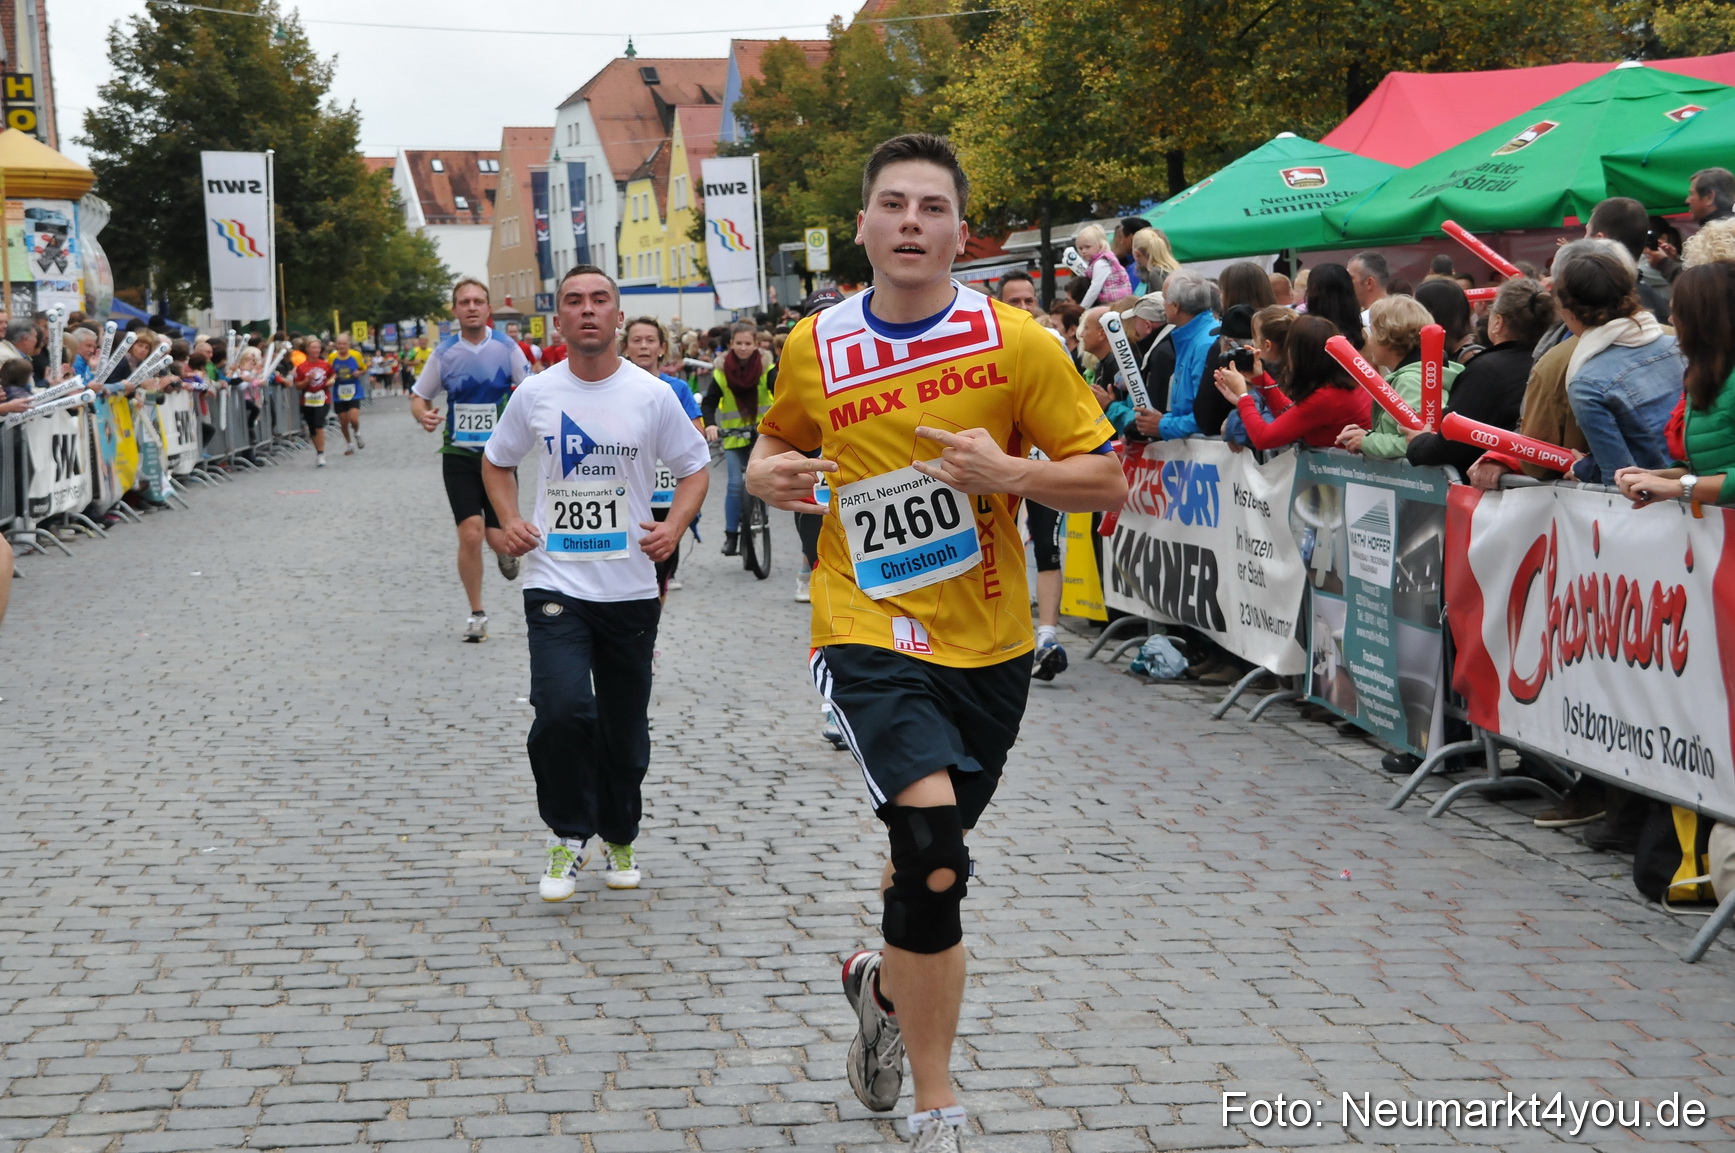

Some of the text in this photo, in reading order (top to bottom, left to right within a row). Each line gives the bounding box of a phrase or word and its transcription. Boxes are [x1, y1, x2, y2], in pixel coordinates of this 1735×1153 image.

[1115, 338, 1134, 373] BMW
[828, 362, 1008, 432] MAX BÖGL
[1377, 382, 1421, 423] Audi BKK
[459, 414, 493, 430] 2125
[573, 462, 616, 476] Team
[1509, 441, 1569, 467] Audi BKK
[547, 489, 613, 497] PARTL Neumarkt
[840, 474, 937, 509] PARTL Neumarkt
[554, 500, 617, 530] 2831
[854, 487, 961, 554] 2460
[563, 537, 611, 549] Christian
[1367, 535, 1391, 553] HOFFER
[880, 543, 958, 580] Christoph
[1507, 515, 1694, 705] Charivari
[1562, 696, 1715, 779] Ostbayerns Radio
